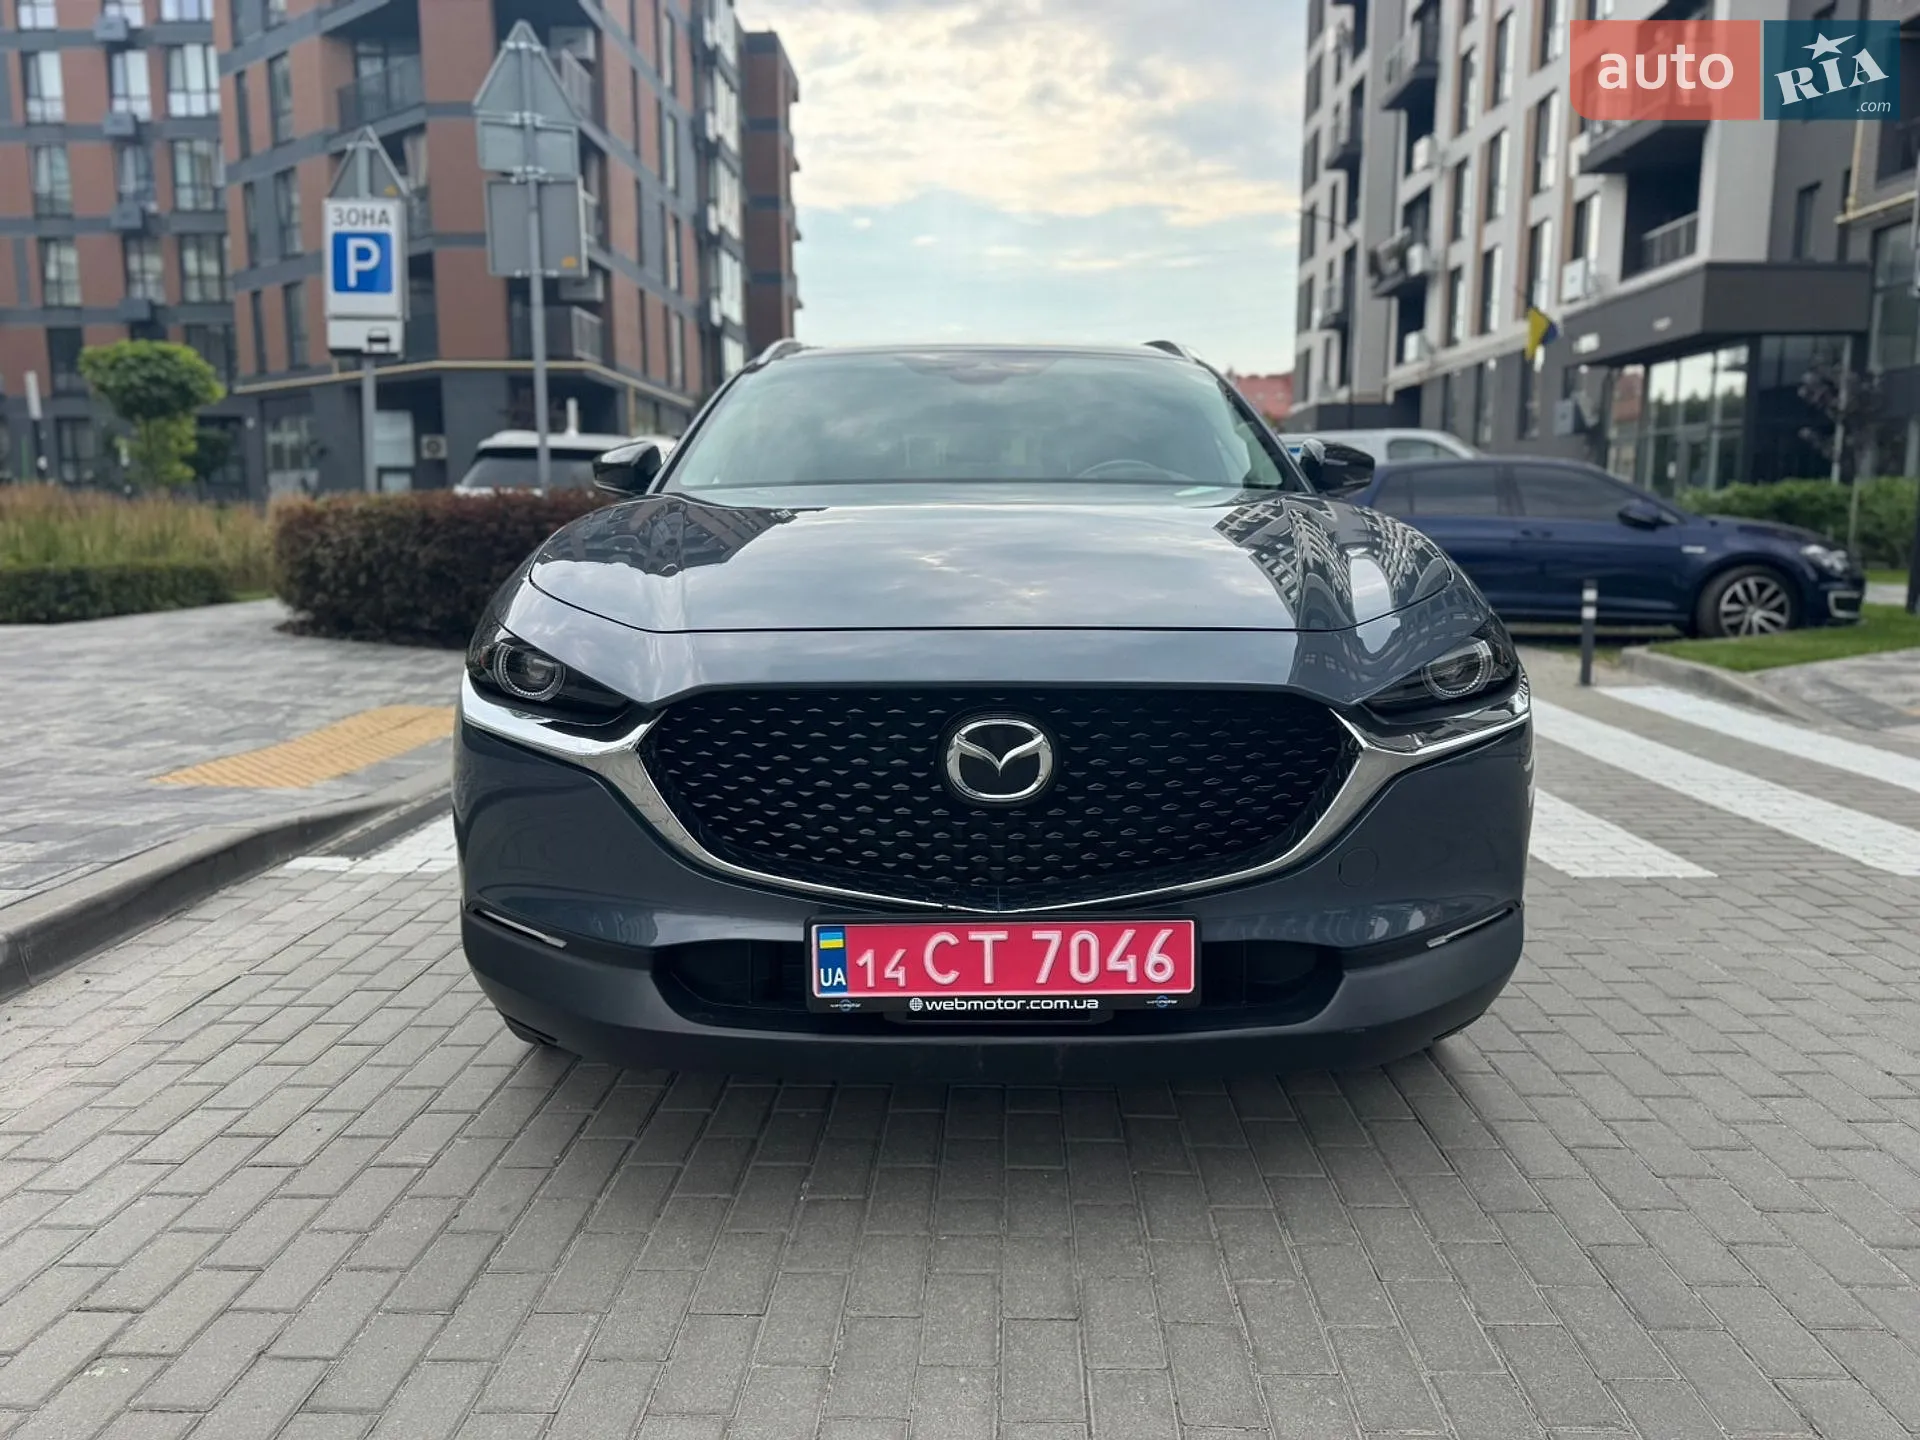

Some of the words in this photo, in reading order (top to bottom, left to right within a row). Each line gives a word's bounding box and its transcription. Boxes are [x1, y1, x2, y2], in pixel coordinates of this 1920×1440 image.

[332, 207, 391, 227] ЗОНА
[346, 237, 381, 288] P
[856, 949, 907, 988] 14
[923, 931, 1009, 985] CT
[1032, 929, 1175, 984] 7046
[820, 967, 847, 987] UA
[925, 998, 1099, 1011] webmotor.com.ua
